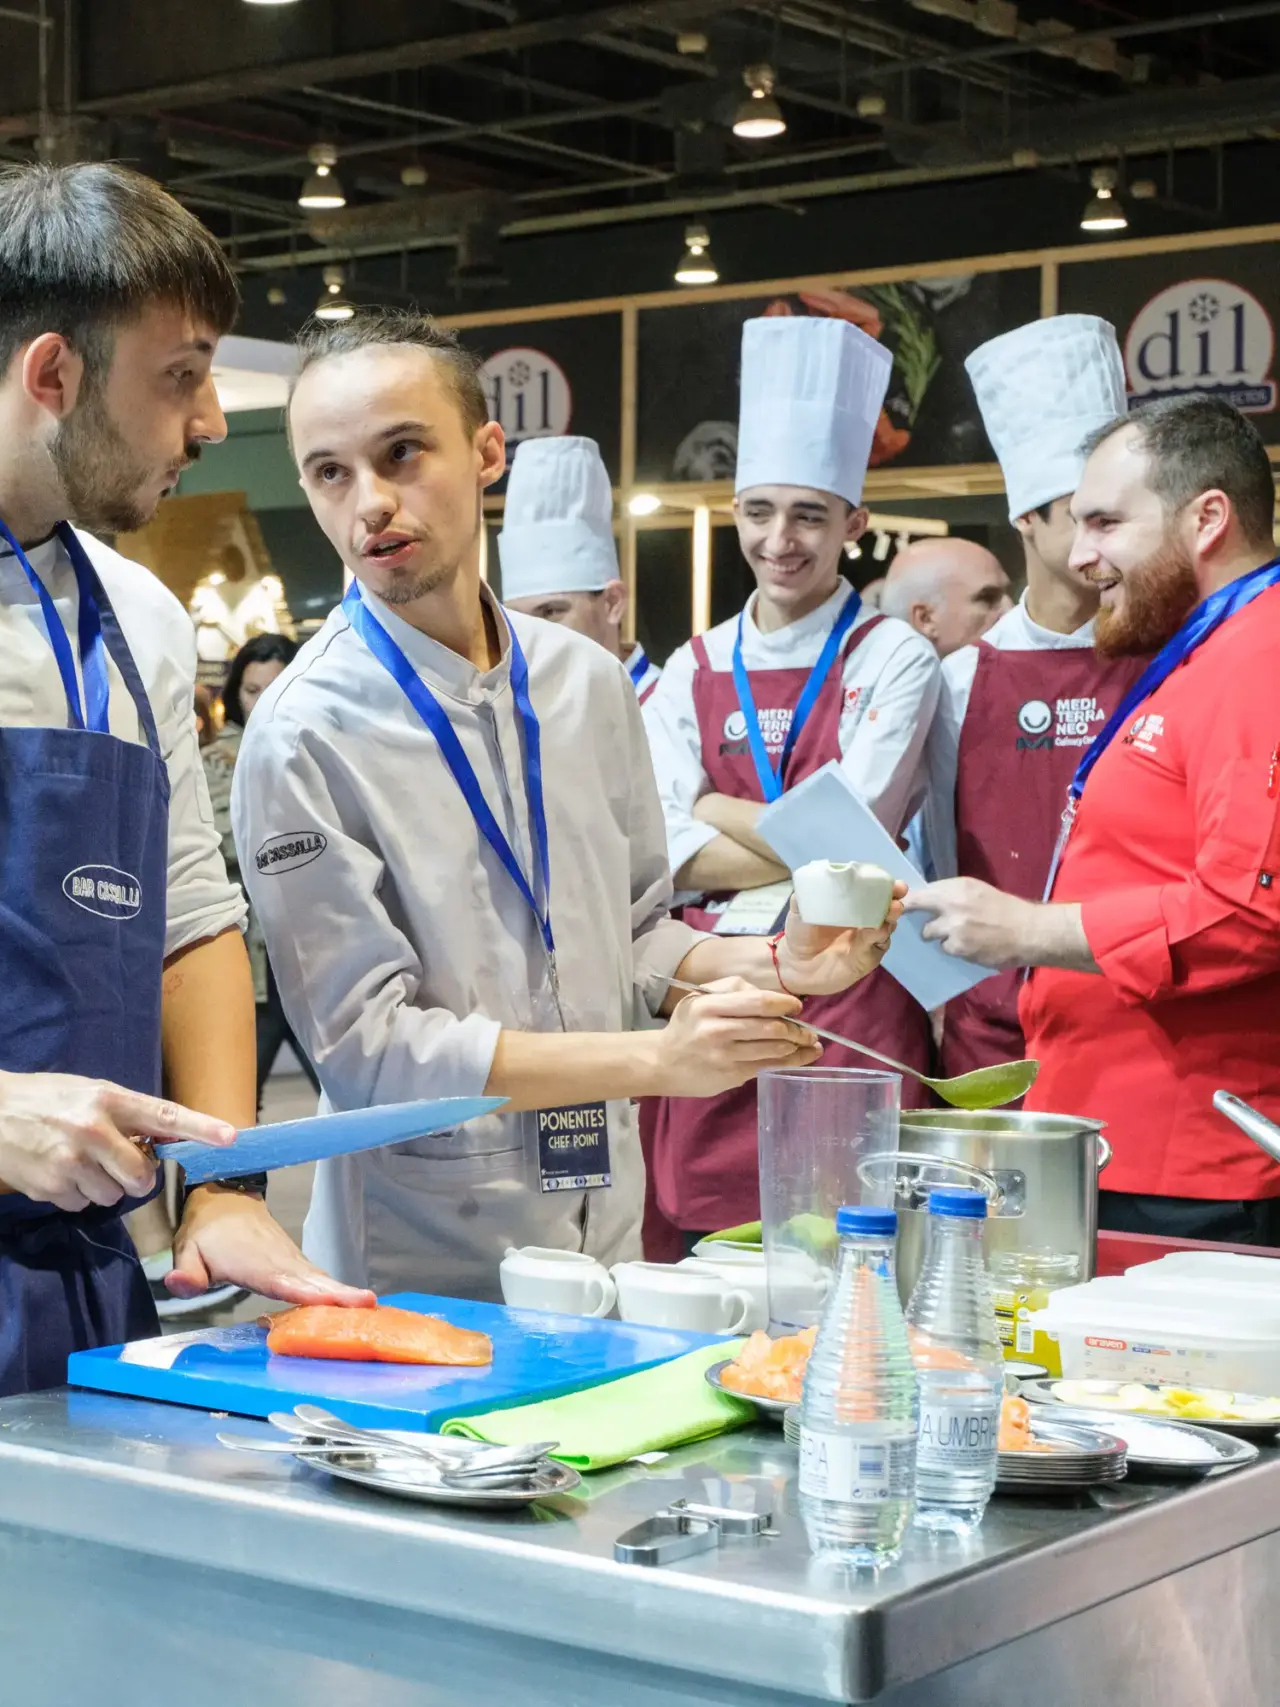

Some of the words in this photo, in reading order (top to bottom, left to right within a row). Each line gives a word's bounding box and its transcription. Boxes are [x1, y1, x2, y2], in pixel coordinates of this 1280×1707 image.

[1137, 293, 1249, 381] dil
[1055, 697, 1096, 711] MEDI
[757, 708, 793, 721] MEDI
[1056, 708, 1105, 723] TERRA
[1056, 721, 1089, 735] NEO
[72, 876, 95, 899] BAR
[540, 1108, 605, 1131] PONENTES
[548, 1135, 570, 1149] CHEF
[573, 1133, 599, 1148] POINT
[1088, 1338, 1123, 1349] araven
